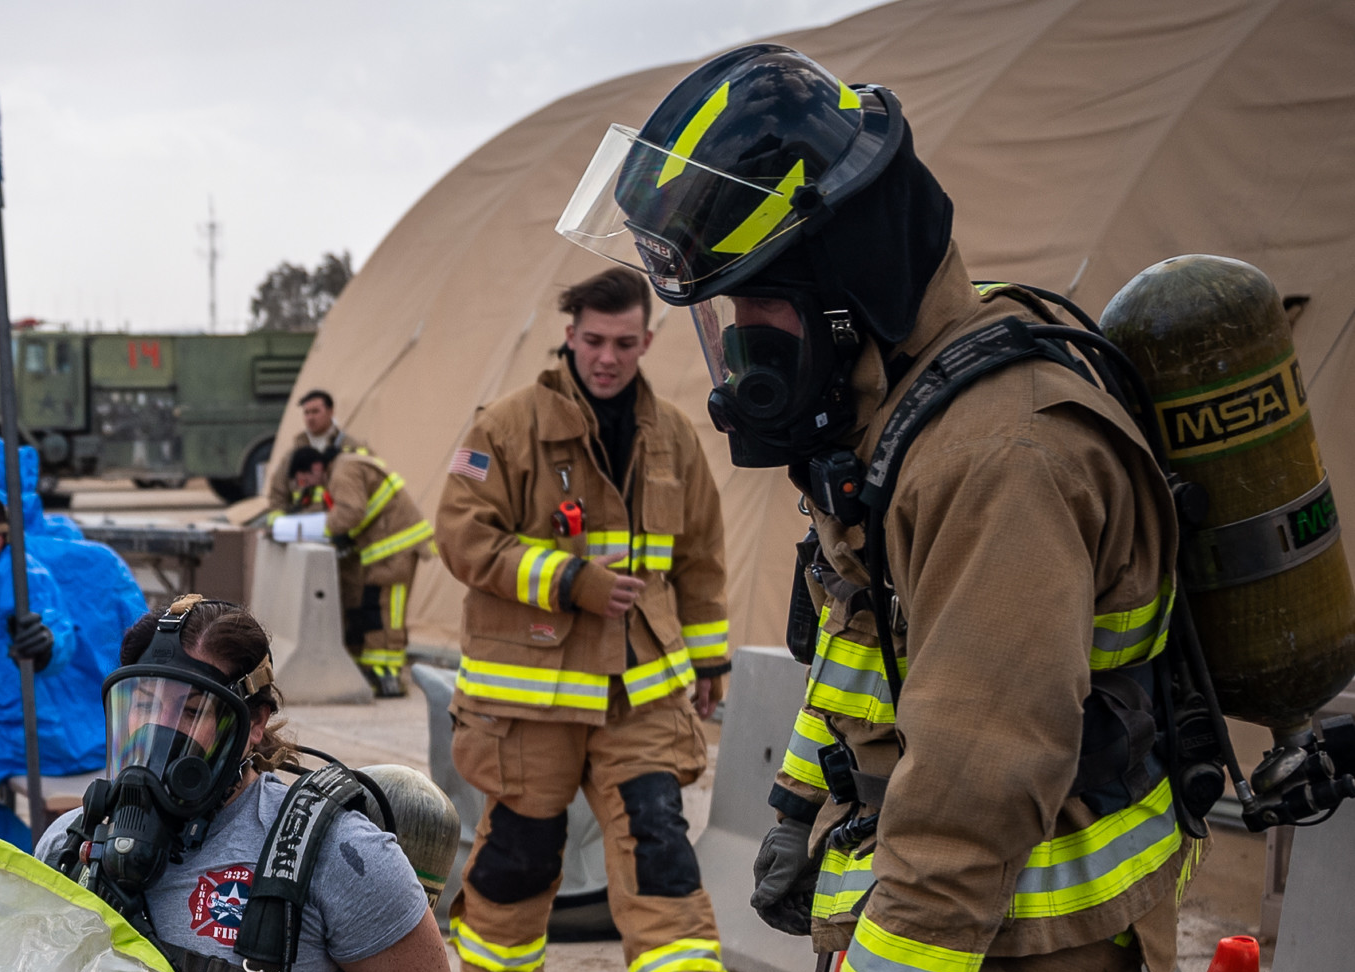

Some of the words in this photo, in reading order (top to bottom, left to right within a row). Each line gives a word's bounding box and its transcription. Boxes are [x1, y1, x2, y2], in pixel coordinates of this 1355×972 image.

[127, 341, 161, 370] 14
[1175, 384, 1286, 444] MSA
[1296, 492, 1336, 541] MS
[223, 870, 249, 881] 332
[194, 883, 207, 921] CRASH
[212, 926, 238, 941] FIR
